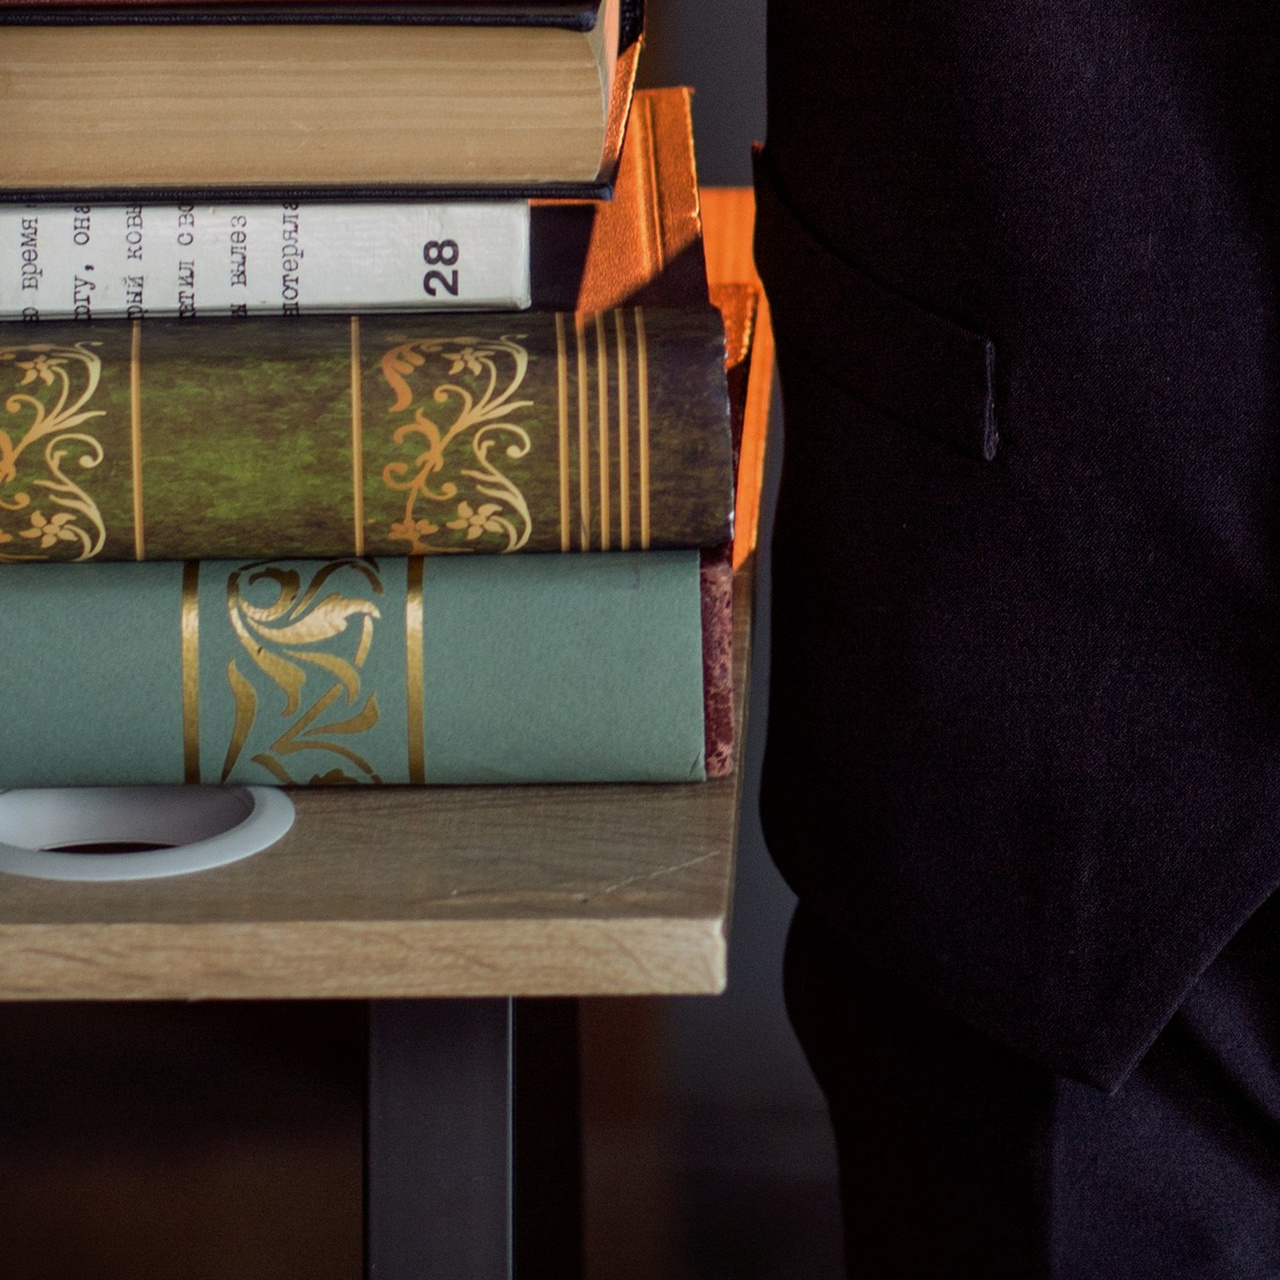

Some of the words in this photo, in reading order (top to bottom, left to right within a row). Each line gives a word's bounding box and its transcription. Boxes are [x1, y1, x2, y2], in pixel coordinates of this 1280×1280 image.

[21, 217, 42, 290] время
[230, 214, 248, 287] вылез
[423, 239, 459, 297] 28
